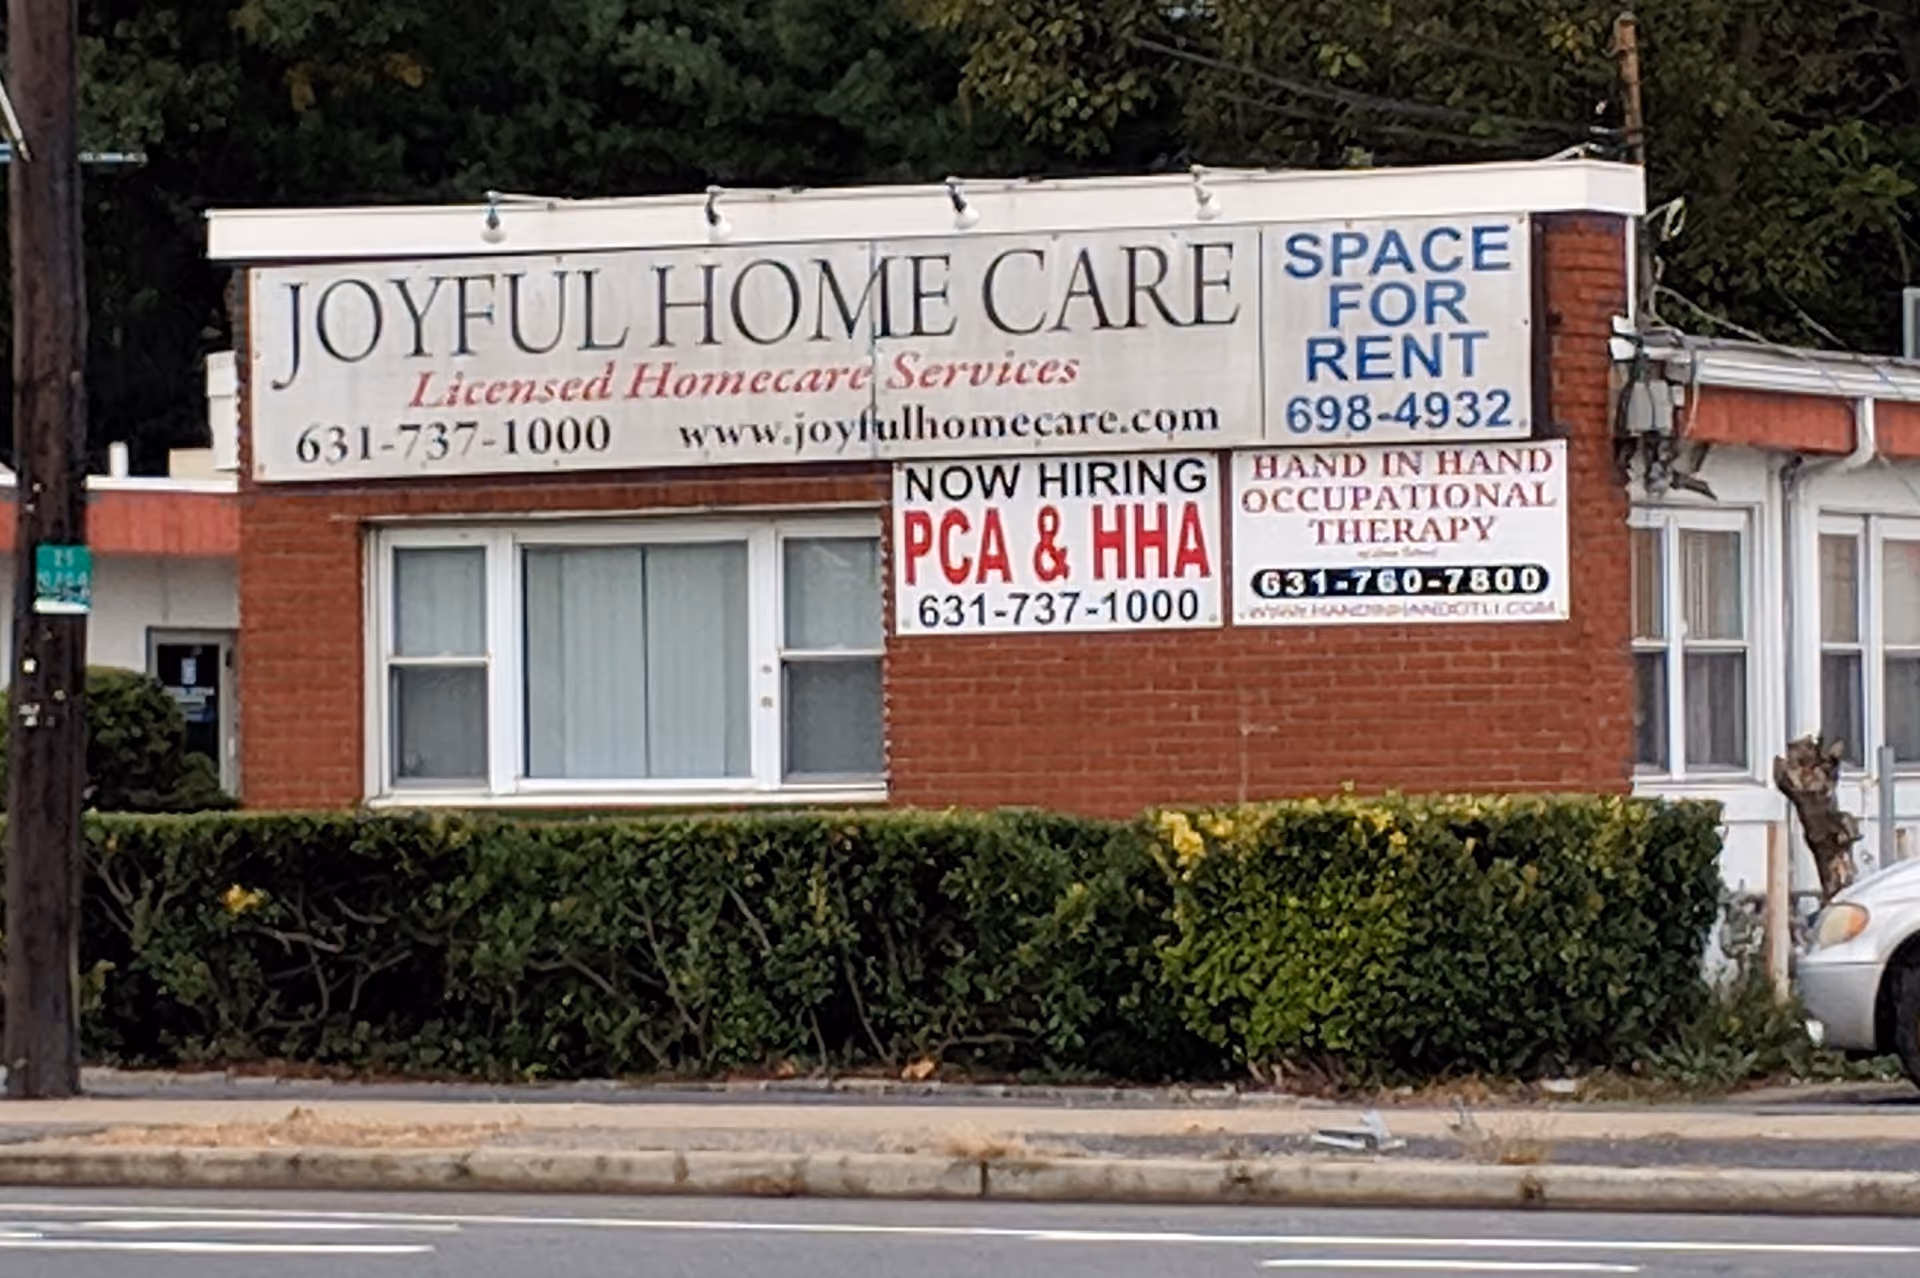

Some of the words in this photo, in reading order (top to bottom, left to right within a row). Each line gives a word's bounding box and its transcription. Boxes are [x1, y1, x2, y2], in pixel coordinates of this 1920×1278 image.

[1284, 225, 1511, 279] SPACE
[271, 268, 630, 391] JOYFUL
[650, 254, 958, 347] HOME
[983, 241, 1241, 335] CARE
[1329, 279, 1469, 328] FOR
[408, 360, 615, 407] Licensed
[624, 360, 873, 400] Homecare
[885, 350, 1080, 391] Services
[1306, 330, 1489, 382] RENT
[679, 403, 1220, 454] www.joyfulhomecare.com
[1286, 389, 1512, 434] 698-4932
[297, 415, 611, 464] 631-737-1000
[1253, 452, 1367, 480] HAND
[1382, 451, 1422, 477] IN
[1437, 448, 1553, 476] HAND
[906, 463, 1020, 502] NOW
[1038, 458, 1207, 498] HIRING
[1241, 481, 1557, 514] OCCUPATIONAL
[904, 507, 1012, 586] PCA
[1033, 504, 1070, 583] &
[1092, 501, 1211, 581] HHA
[1308, 515, 1495, 546] THERAPY
[1260, 567, 1541, 595] 631-760-7800
[919, 589, 1198, 628] 631-737-1000
